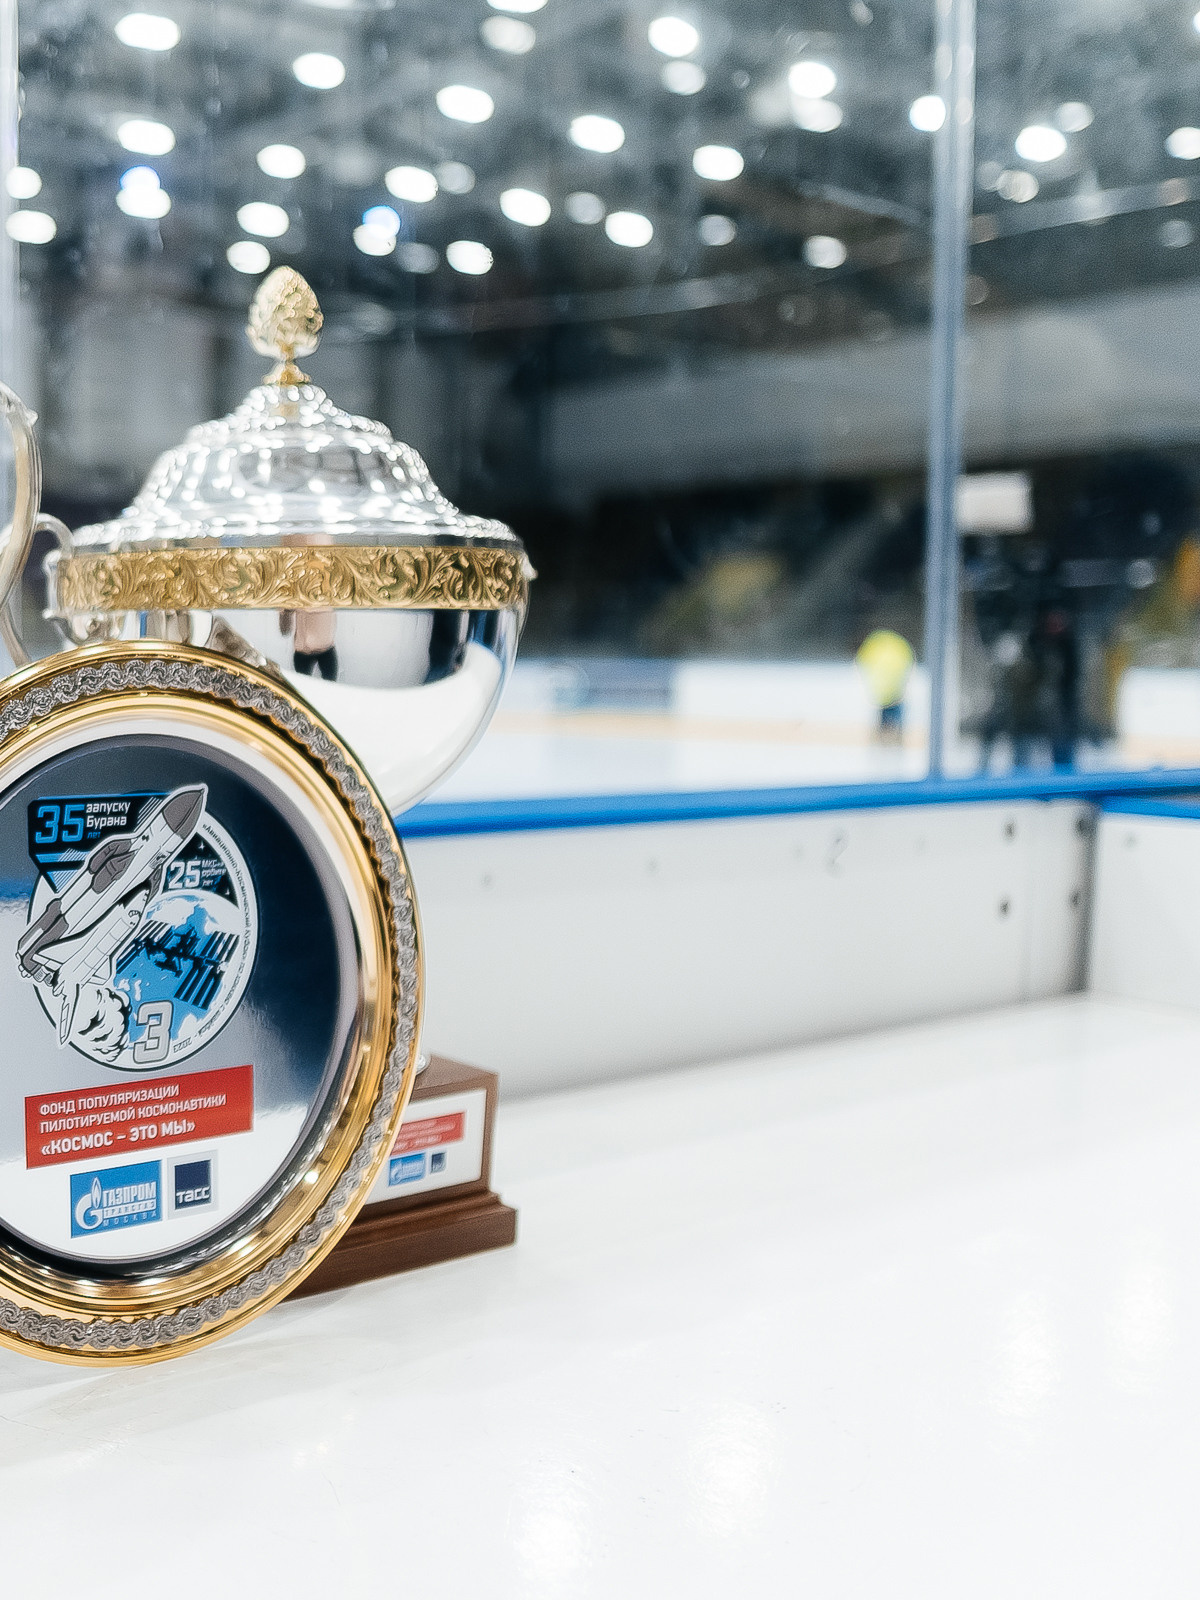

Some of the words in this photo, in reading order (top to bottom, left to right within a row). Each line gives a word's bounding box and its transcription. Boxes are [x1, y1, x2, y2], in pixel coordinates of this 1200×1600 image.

[86, 802, 131, 815] запуску
[86, 815, 127, 829] Бурана
[35, 804, 85, 844] 35
[168, 860, 201, 889] 25
[133, 1000, 173, 1064] 3
[40, 1100, 76, 1116] ФОНД
[78, 1084, 180, 1111] ПОПУЛЯРИЗАЦИИ
[40, 1106, 135, 1133] ПИЛОТИРУЕМОЙ
[138, 1094, 226, 1118] КОСМОНАВТИКИ
[40, 1131, 113, 1156] «КОСМОС
[129, 1124, 157, 1142] ЭТО
[161, 1119, 195, 1137] МЫ»
[102, 1181, 157, 1208] ГАЗПРОМ
[103, 1211, 157, 1226] МОСКВА
[104, 1201, 156, 1218] ТРАНСГАЗ
